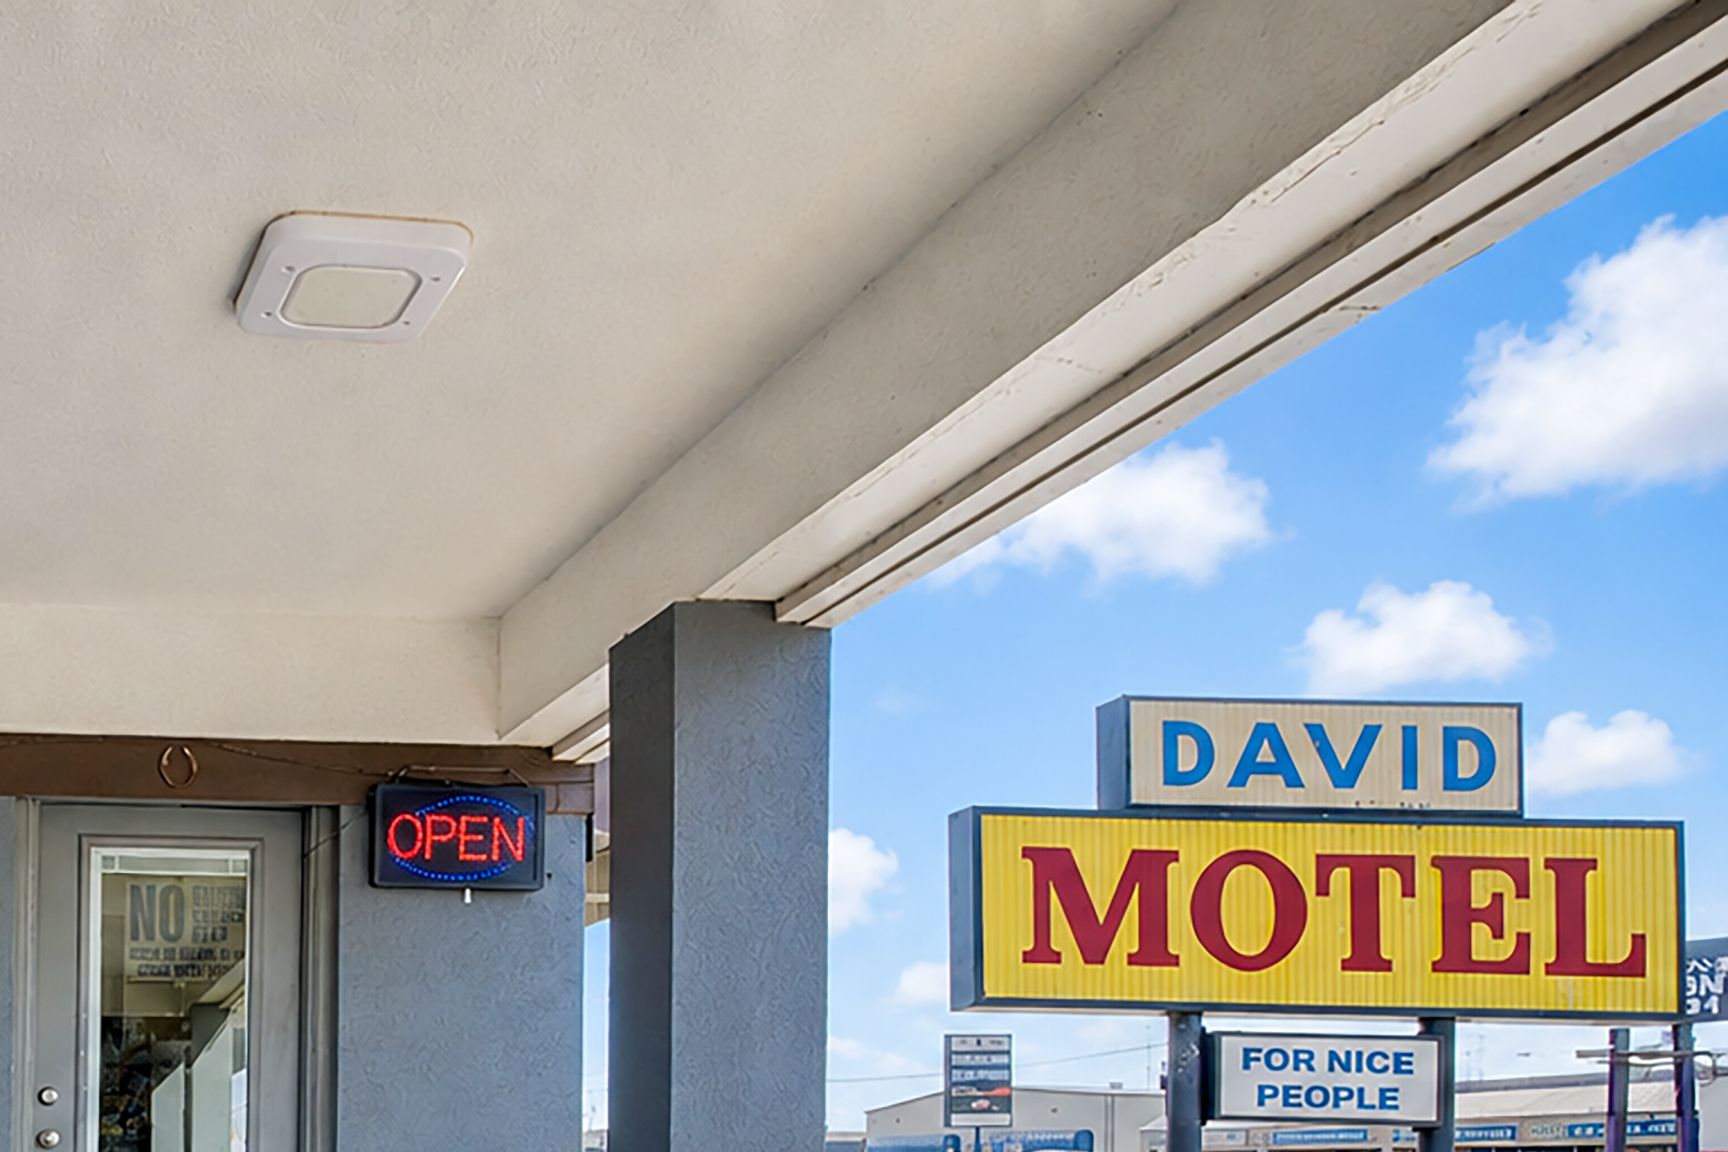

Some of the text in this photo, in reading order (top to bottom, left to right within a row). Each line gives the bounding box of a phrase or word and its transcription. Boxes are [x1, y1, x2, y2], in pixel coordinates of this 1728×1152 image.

[1160, 720, 1497, 792] DAVID
[386, 812, 526, 862] OPEN
[129, 883, 186, 943] NO
[1020, 845, 1647, 978] MOTEL
[1241, 1046, 1414, 1076] FOR NICE
[1256, 1083, 1400, 1111] PEOPLE
